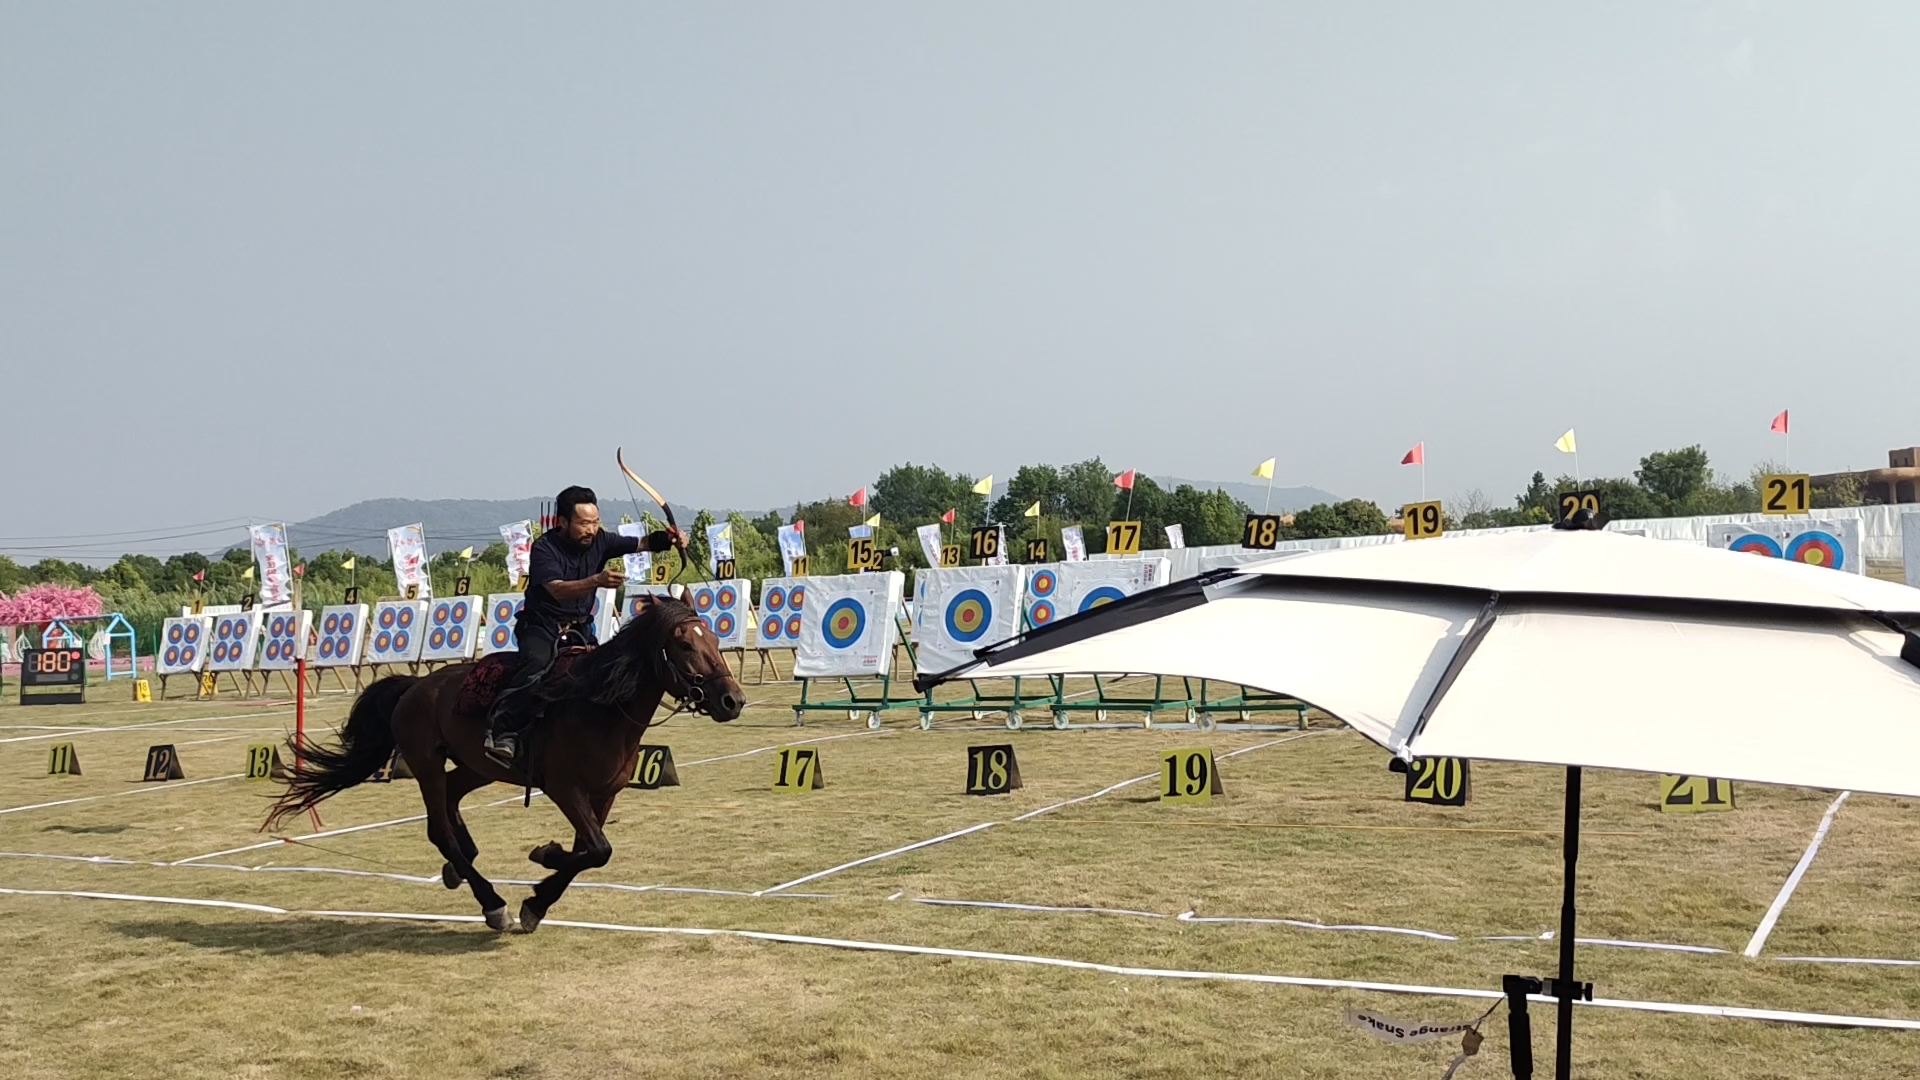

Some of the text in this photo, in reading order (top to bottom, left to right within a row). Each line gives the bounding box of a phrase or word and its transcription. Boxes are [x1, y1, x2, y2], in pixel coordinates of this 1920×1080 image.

[1767, 478, 1804, 510] 21
[1407, 504, 1439, 536] 19
[973, 529, 997, 556] 16
[1112, 525, 1138, 550] 17
[1247, 519, 1274, 547] 18
[851, 540, 871, 565] 15
[942, 546, 958, 565] 13
[1027, 541, 1046, 560] 14
[656, 565, 666, 582] 9
[717, 561, 734, 578] 10
[793, 557, 807, 575] 11
[407, 585, 416, 600] 5
[458, 578, 467, 594] 6
[521, 574, 529, 590] 7
[195, 600, 200, 613] 1
[244, 596, 252, 611] 2
[347, 591, 355, 604] 4
[37, 651, 71, 672] 180
[48, 744, 69, 774] 11
[147, 749, 170, 779] 12
[249, 747, 271, 778] 13
[628, 748, 664, 785] 16
[774, 749, 814, 787] 17
[970, 750, 1008, 790] 18
[1163, 753, 1208, 797] 19
[1410, 757, 1462, 800] 20
[1665, 775, 1727, 805] 21
[1357, 1014, 1405, 1038] Snake
